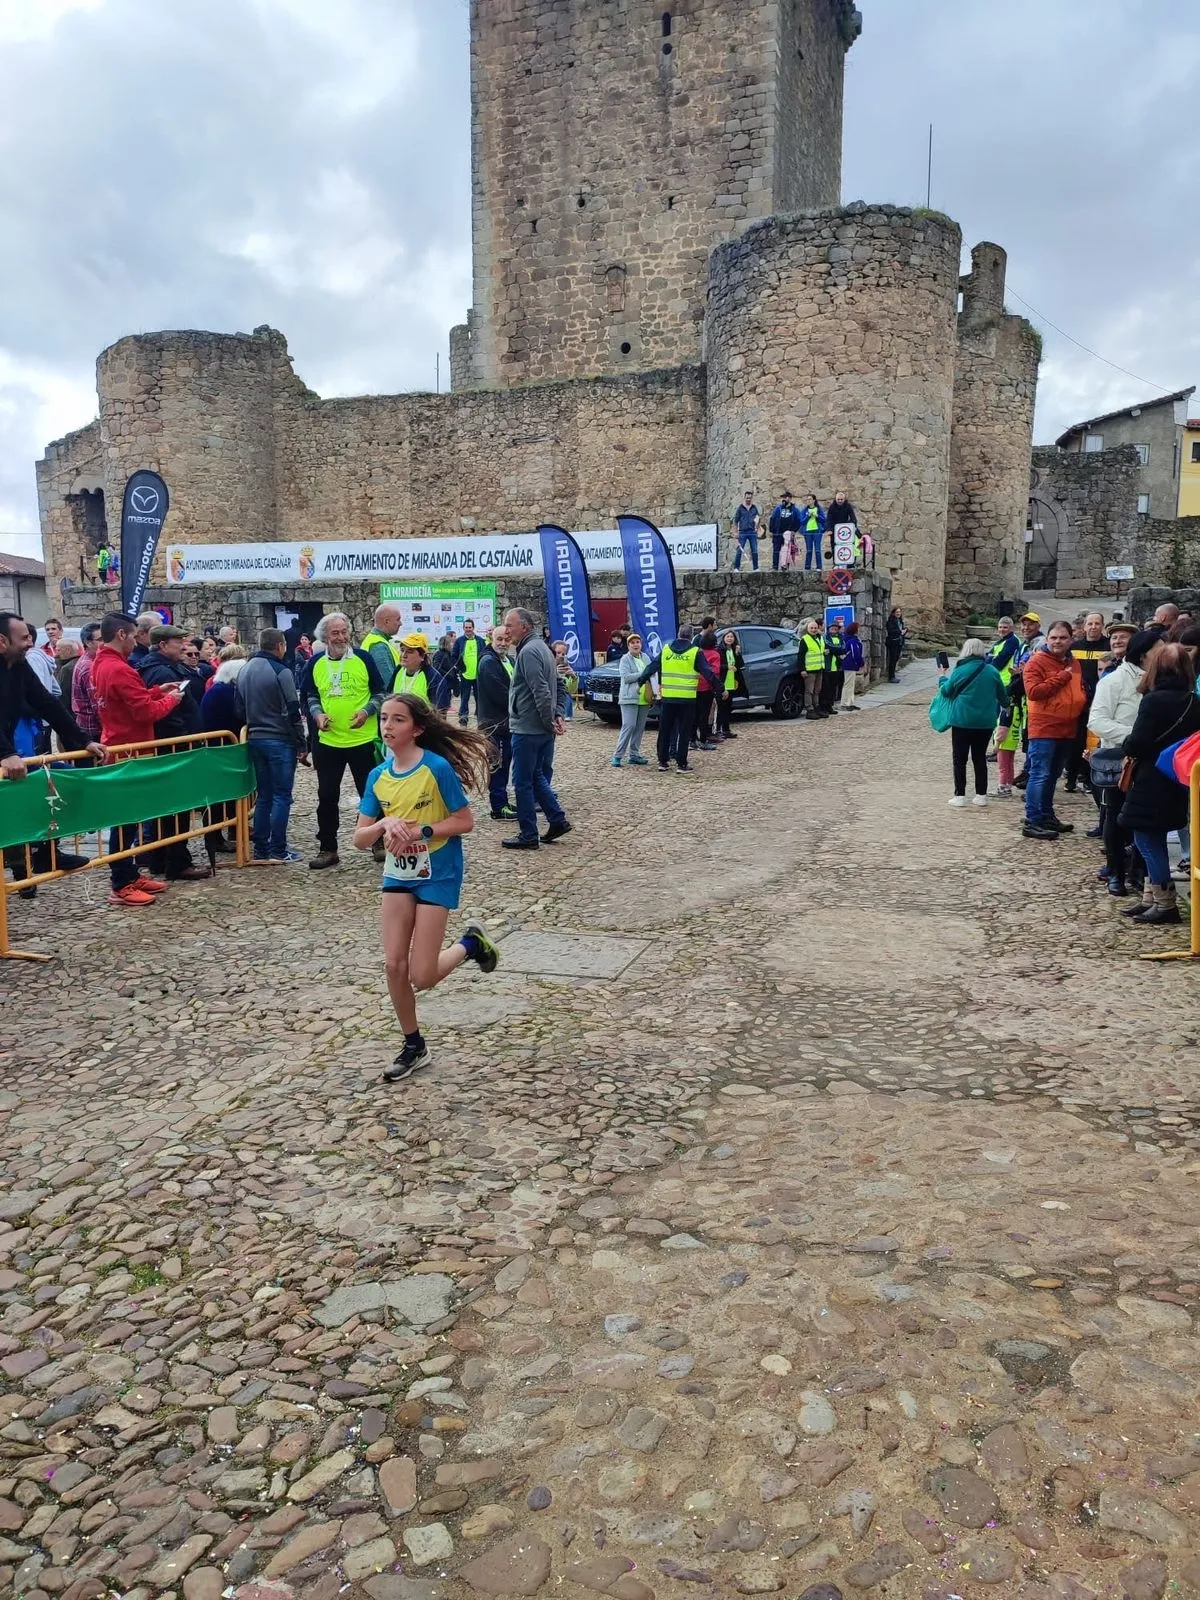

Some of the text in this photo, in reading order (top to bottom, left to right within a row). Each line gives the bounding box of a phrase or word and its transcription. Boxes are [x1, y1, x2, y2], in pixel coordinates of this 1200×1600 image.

[324, 544, 533, 571] AYUNTAMIENTO DE MIRANDA DEL CASTAÑAR
[581, 546, 623, 560] UNTAMIENTO
[677, 539, 713, 555] CASTAÑAR
[185, 554, 291, 570] AYUNTAMIENTO DE MIRANDA DEL CASTAÑAR
[127, 536, 156, 616] Monumotor
[383, 587, 391, 598] LA
